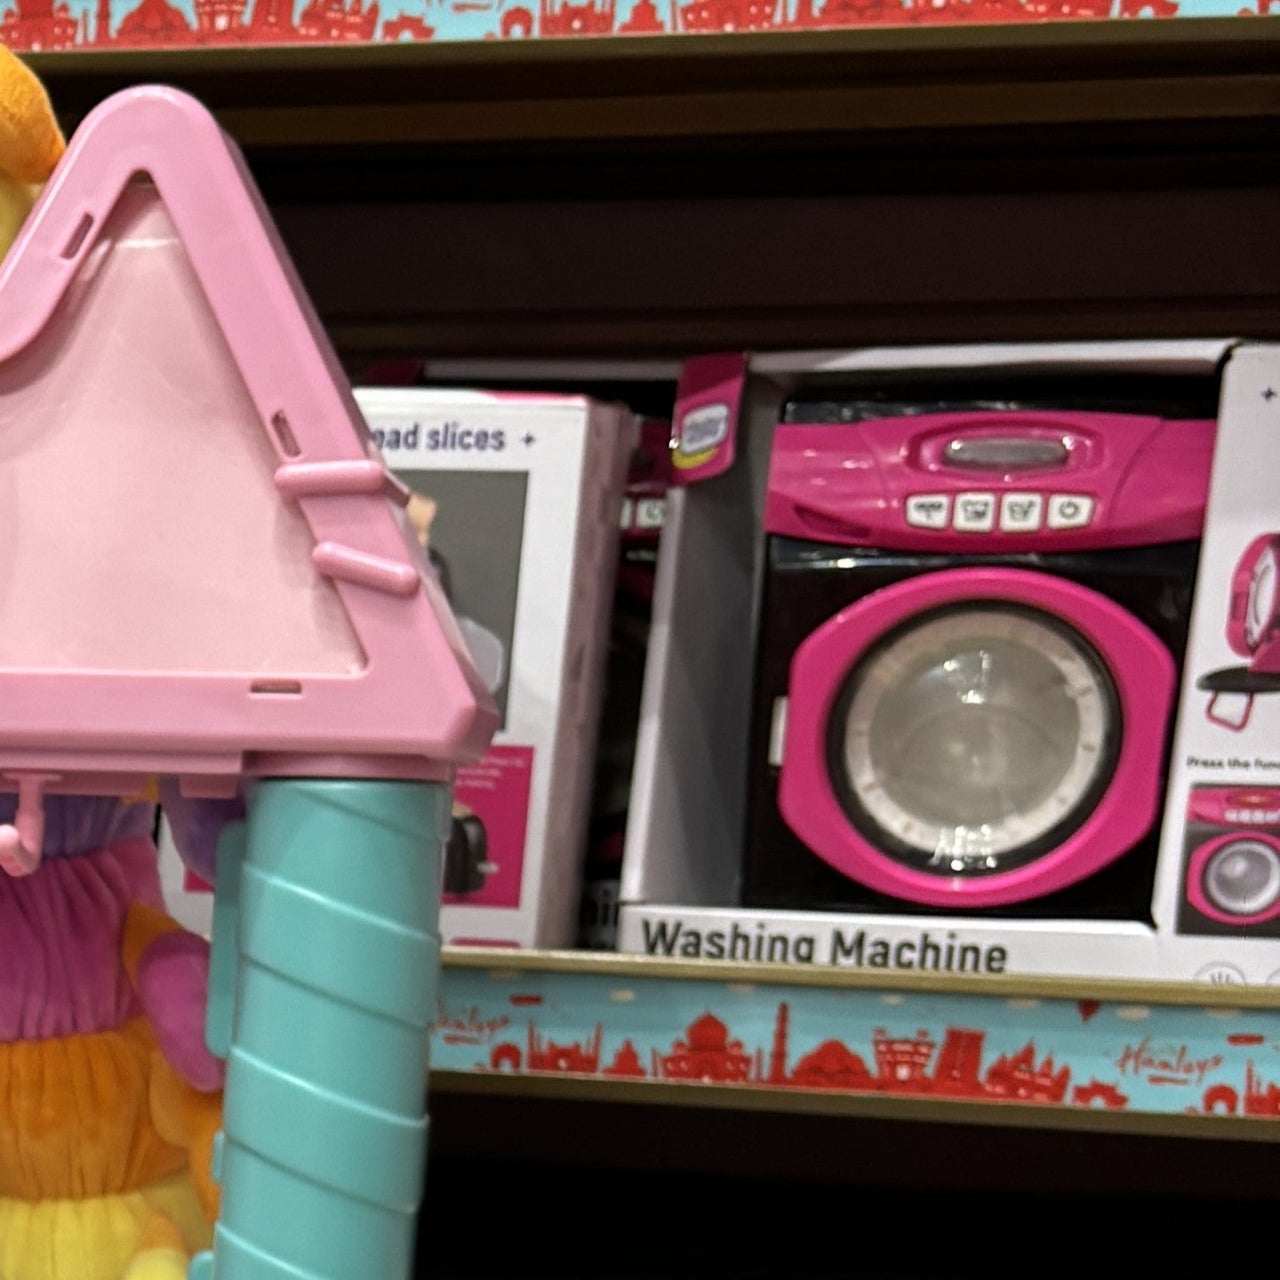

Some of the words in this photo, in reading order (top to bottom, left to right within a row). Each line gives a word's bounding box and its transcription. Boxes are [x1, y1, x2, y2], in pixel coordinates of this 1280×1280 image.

[426, 421, 506, 452] slices
[641, 919, 817, 964] Washing
[828, 929, 1008, 974] Machine
